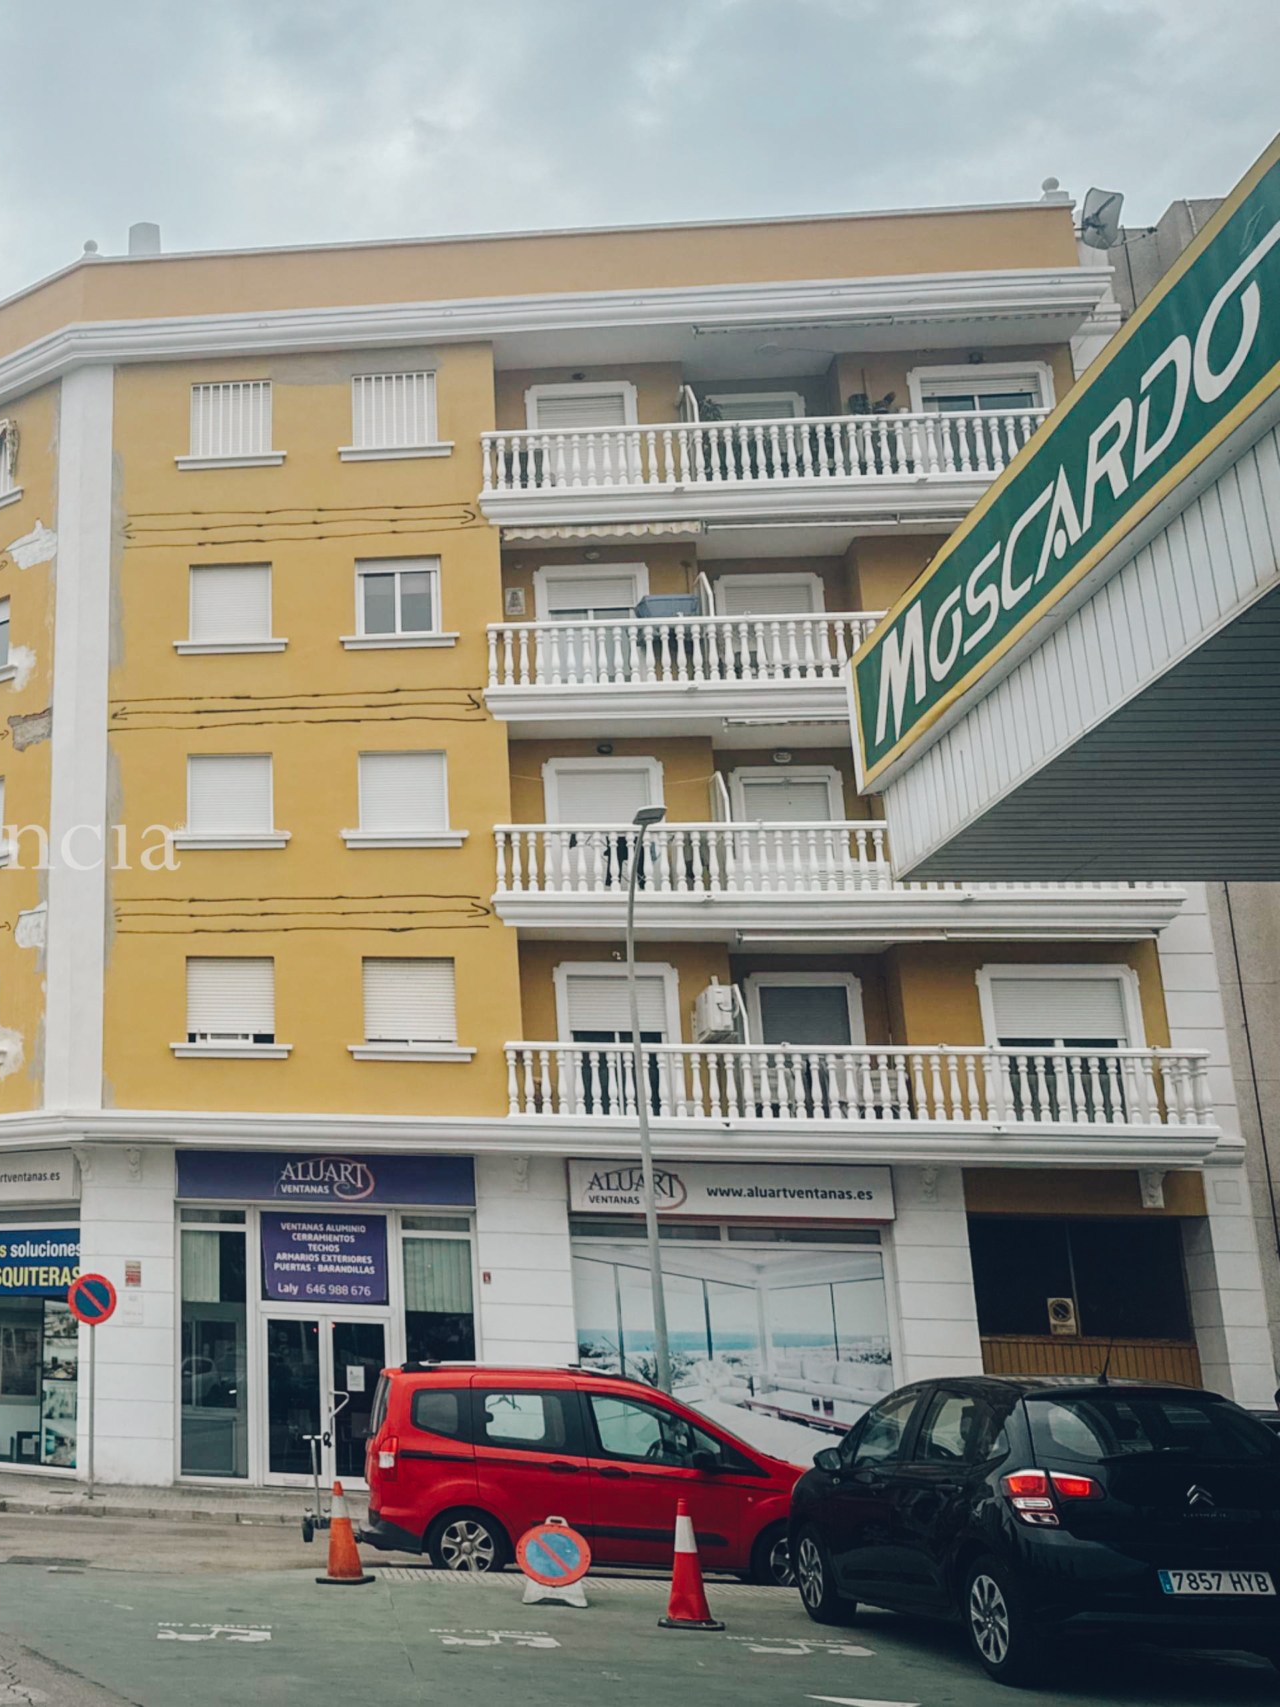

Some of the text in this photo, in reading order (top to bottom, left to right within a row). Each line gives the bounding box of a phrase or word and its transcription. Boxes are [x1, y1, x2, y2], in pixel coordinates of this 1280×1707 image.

[874, 219, 1280, 746] MOSCARDO
[281, 1159, 368, 1188] ALUART
[281, 1184, 330, 1195] VENTANAS
[706, 1185, 873, 1201] www.aluartventanas.es
[588, 1194, 640, 1206] VENTANAS
[280, 1222, 367, 1234] VENTANAS ALUMINIO
[291, 1232, 356, 1243] CERRAMIENTOS
[307, 1243, 340, 1253] TECHOS
[275, 1252, 373, 1265] ARMARIOS EXTERIORES
[273, 1262, 312, 1272] PUERTAS
[317, 1263, 376, 1275] BARANDILLAS
[277, 1282, 372, 1297] Laly 646 988 676
[1171, 1571, 1270, 1593] 7857 HYB
